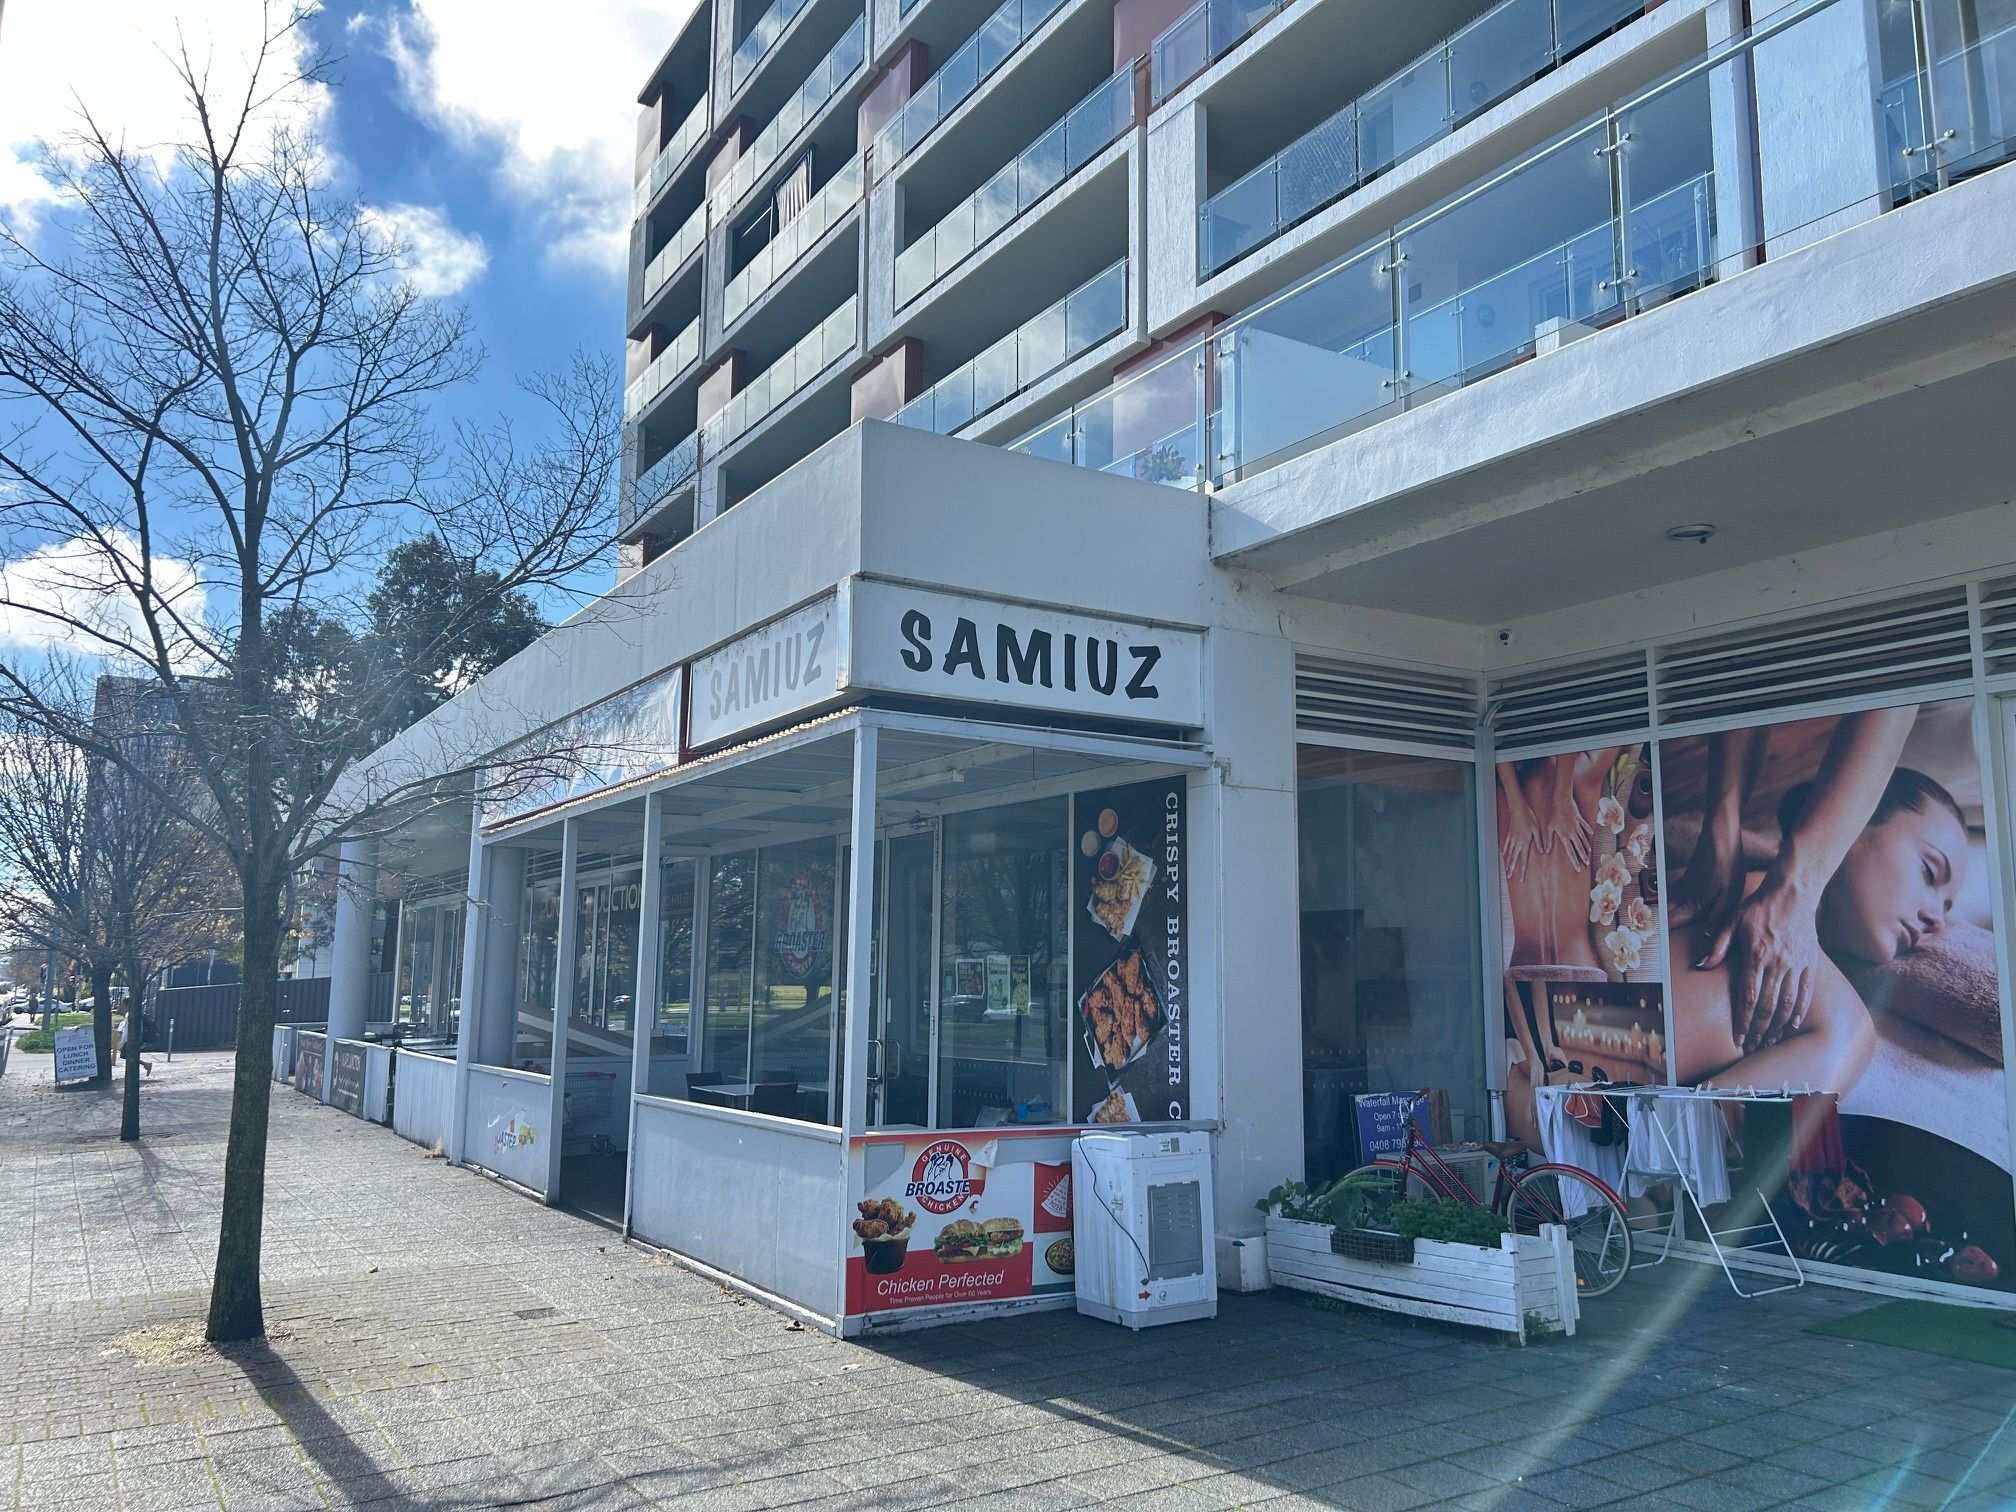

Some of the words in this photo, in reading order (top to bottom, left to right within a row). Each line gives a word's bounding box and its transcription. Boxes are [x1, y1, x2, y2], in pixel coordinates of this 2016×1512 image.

[900, 609, 1162, 700] SAMIUZ
[709, 620, 826, 721] SAMIUZ
[1165, 791, 1179, 903] CRISPY
[1166, 915, 1181, 1086] BROASTER
[58, 1063, 96, 1072] CATERING
[1358, 1096, 1390, 1109] Waterfall
[1373, 1112, 1391, 1122] Open
[1391, 1110, 1396, 1119] 7
[1376, 1124, 1391, 1133] 9am
[921, 1144, 967, 1163] GENUINE
[1369, 1139, 1390, 1152] 0408
[921, 1195, 965, 1211] CHICKEN
[877, 1277, 934, 1296] Chicken
[938, 1269, 1005, 1289] Perfected
[904, 1295, 924, 1303] Proven
[953, 1290, 967, 1298] Over
